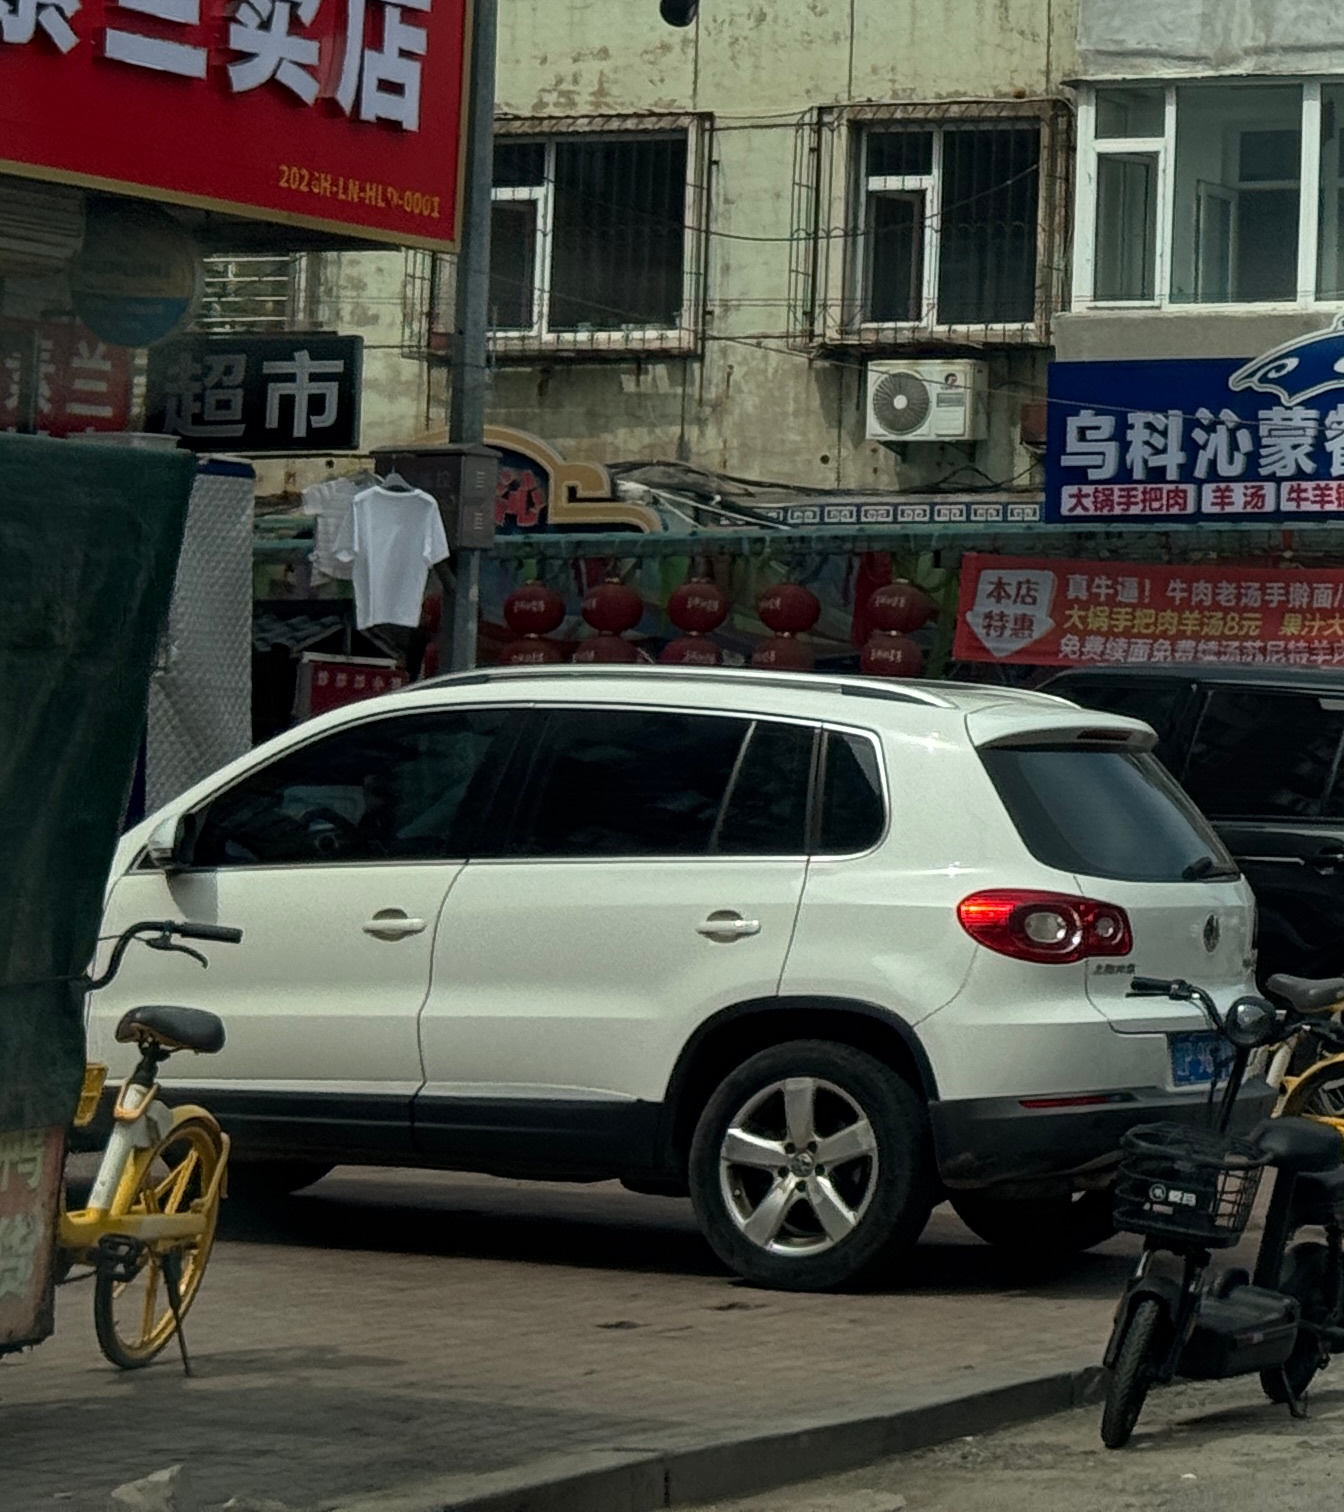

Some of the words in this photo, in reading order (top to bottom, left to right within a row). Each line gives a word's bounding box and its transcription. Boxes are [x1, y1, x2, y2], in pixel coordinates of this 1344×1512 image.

[162, 349, 345, 438] 超市
[1067, 486, 1188, 513] 大锅手把肉
[1210, 484, 1267, 511] 羊汤
[986, 575, 1040, 607] 本店
[981, 609, 1036, 639] 特惠
